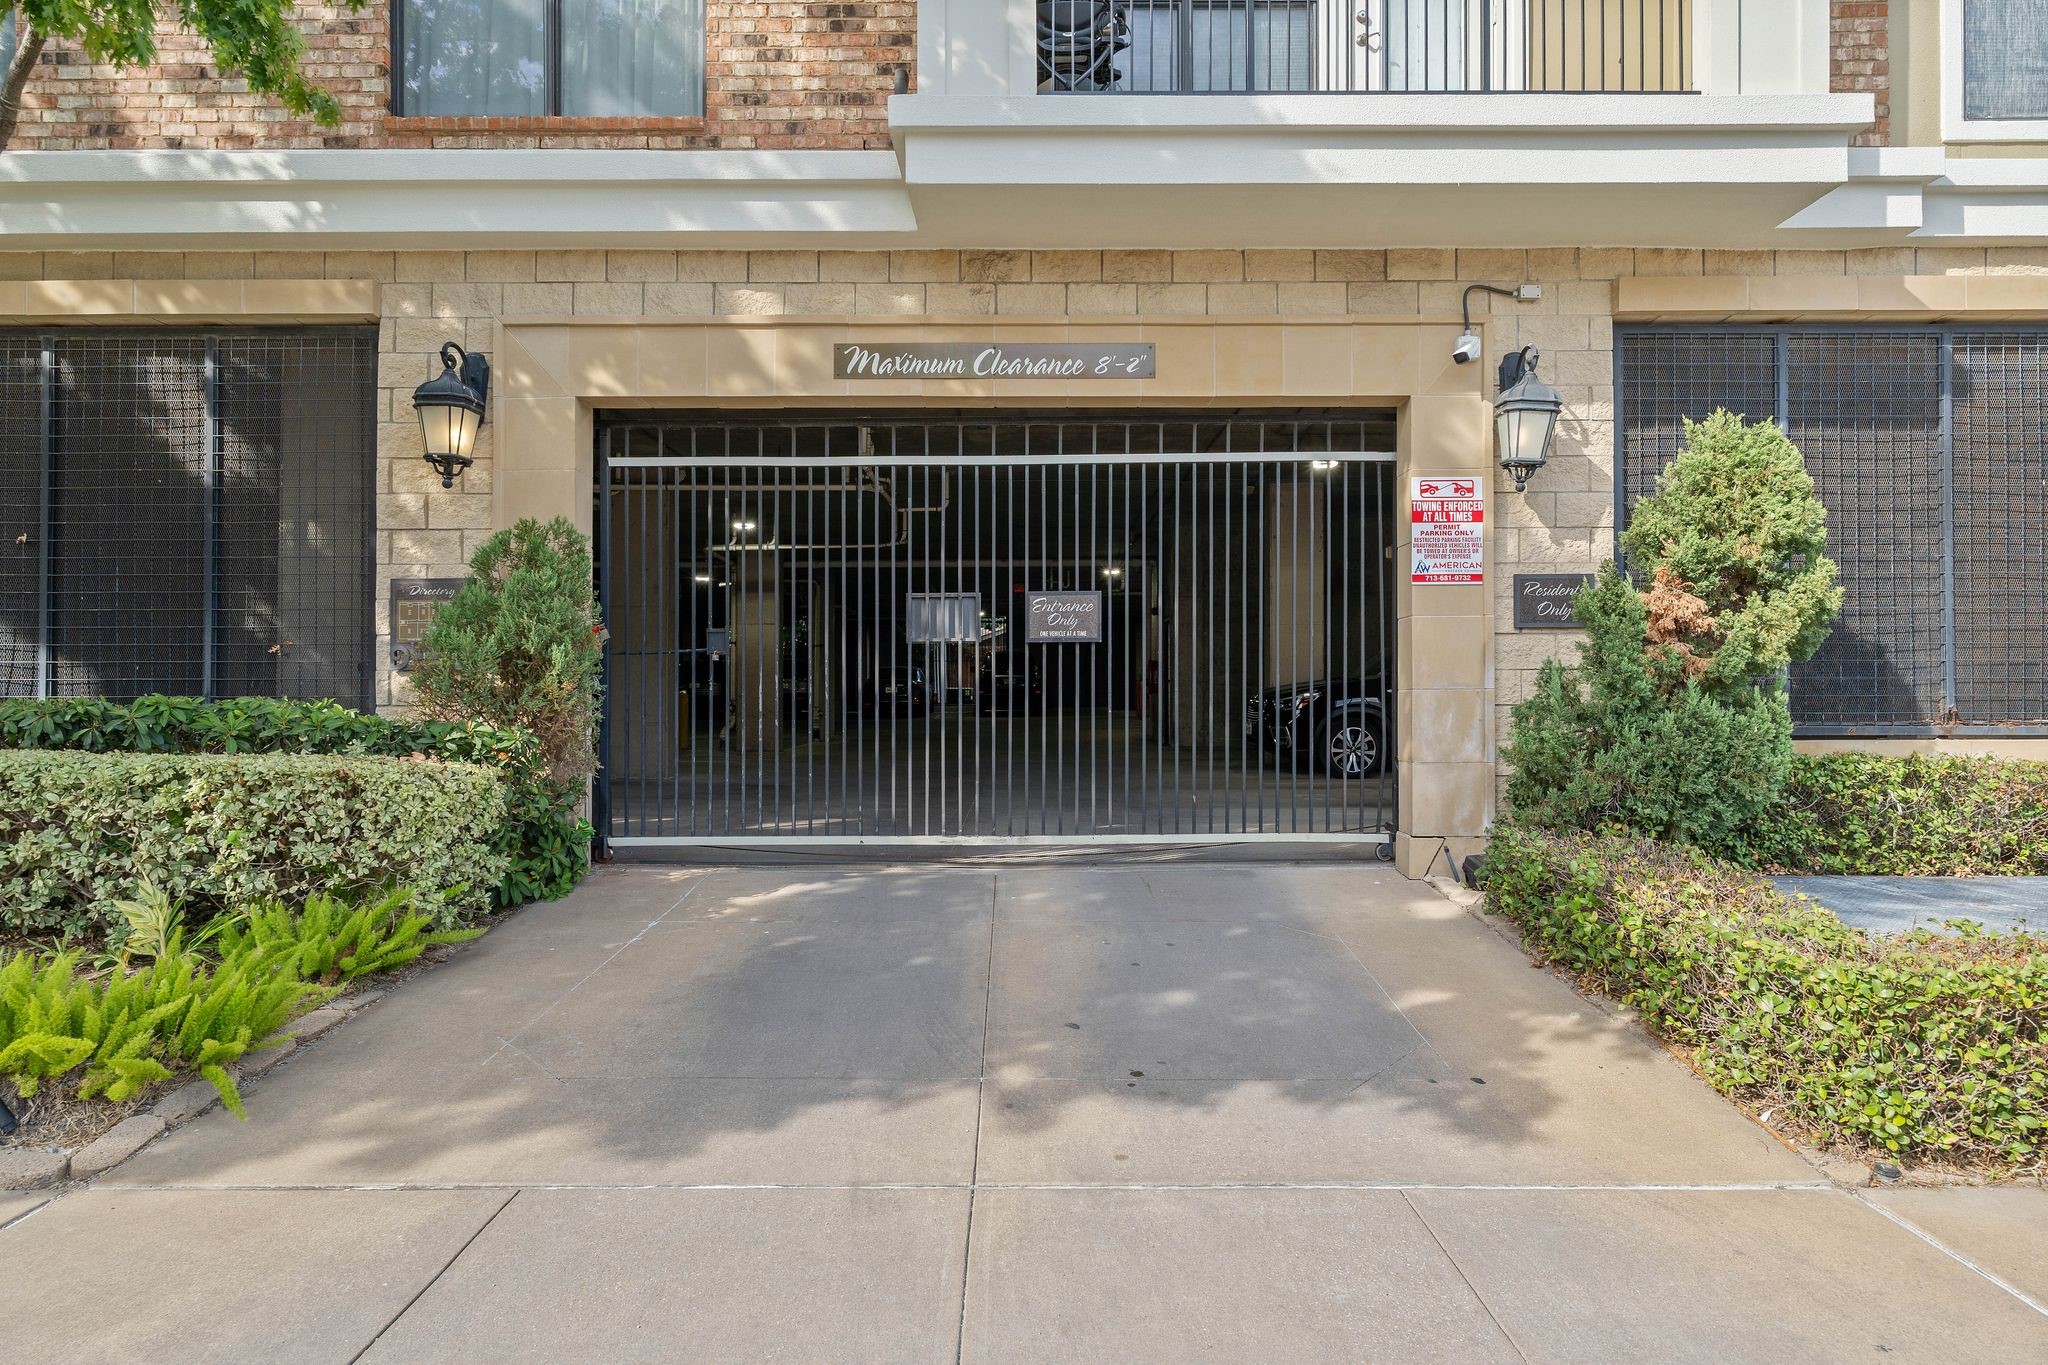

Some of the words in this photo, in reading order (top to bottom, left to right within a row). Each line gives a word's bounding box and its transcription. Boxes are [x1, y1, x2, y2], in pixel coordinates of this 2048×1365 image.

[844, 345, 965, 376] Maximum
[973, 348, 1085, 376] Clearance
[1412, 501, 1442, 512] TOWING
[1443, 501, 1483, 512] ENFORCED
[1422, 511, 1433, 522] AT
[1434, 511, 1448, 522] ALL
[1449, 511, 1473, 522] TIMES
[409, 585, 455, 599] Directory
[1032, 597, 1094, 613] Entrance
[1537, 601, 1572, 621] Only
[1047, 612, 1079, 630] Only
